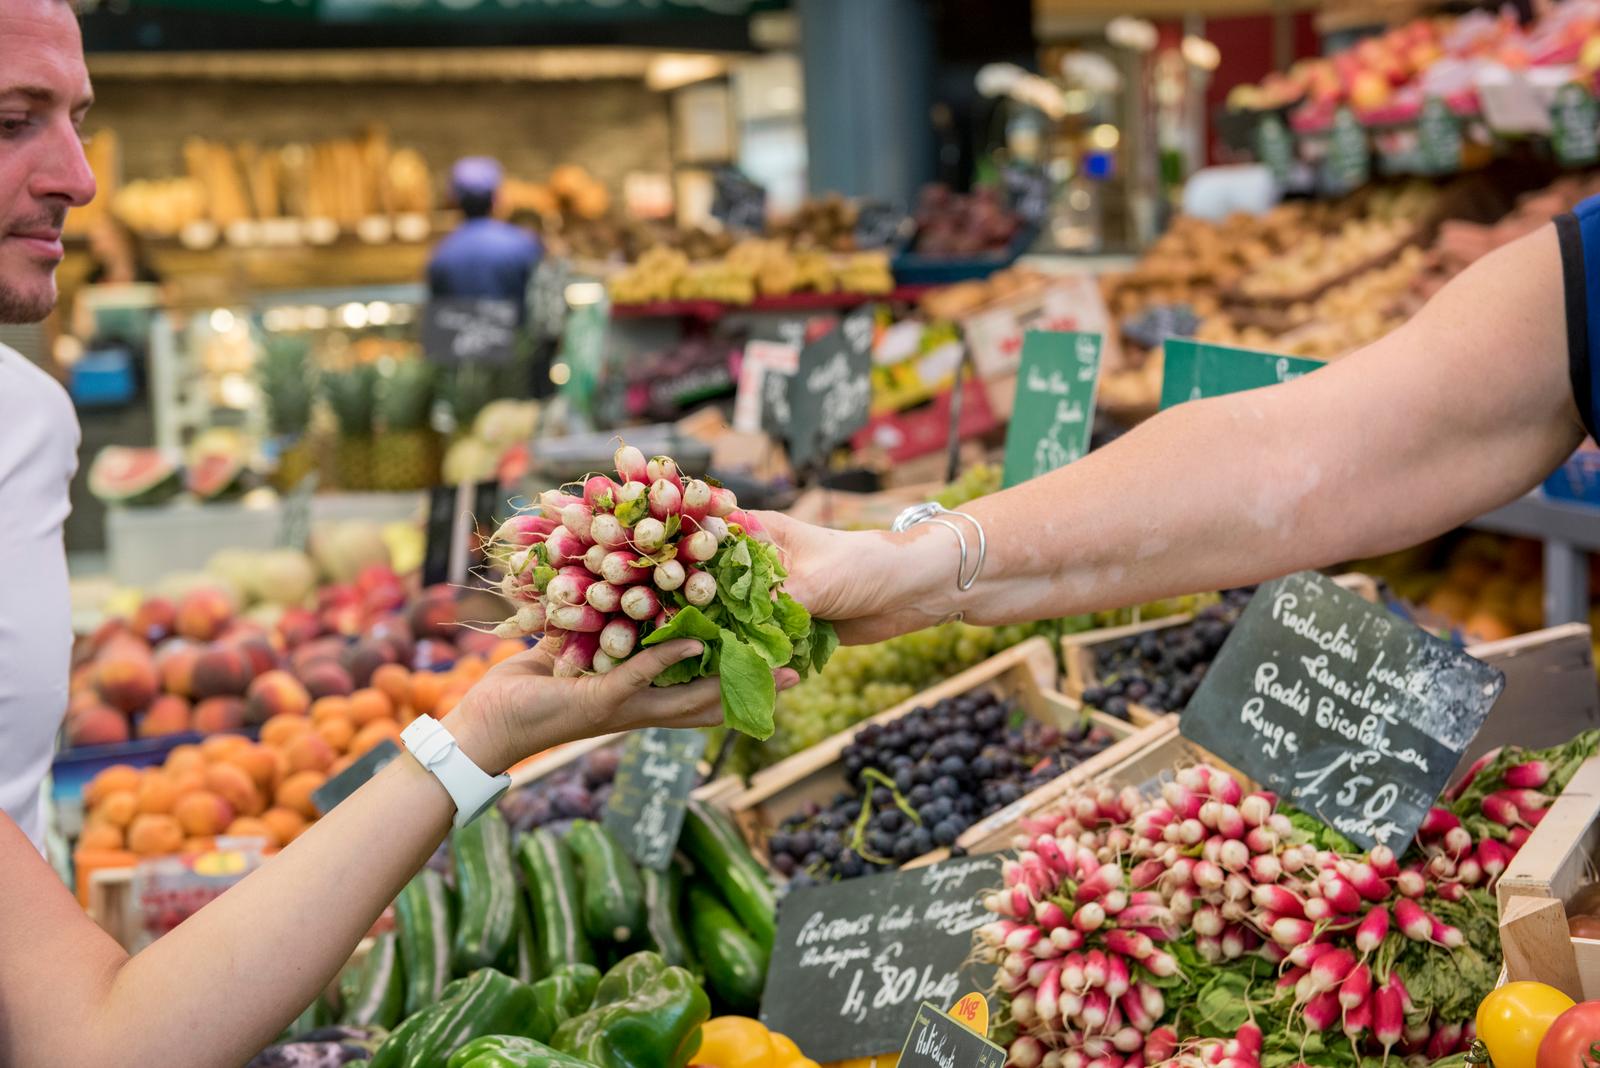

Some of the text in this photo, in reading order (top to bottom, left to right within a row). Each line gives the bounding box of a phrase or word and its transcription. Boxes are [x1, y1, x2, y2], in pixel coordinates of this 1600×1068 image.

[1253, 662, 1311, 717] Radis
[840, 964, 918, 1024] 4,80
[958, 997, 981, 1021] 1kg
